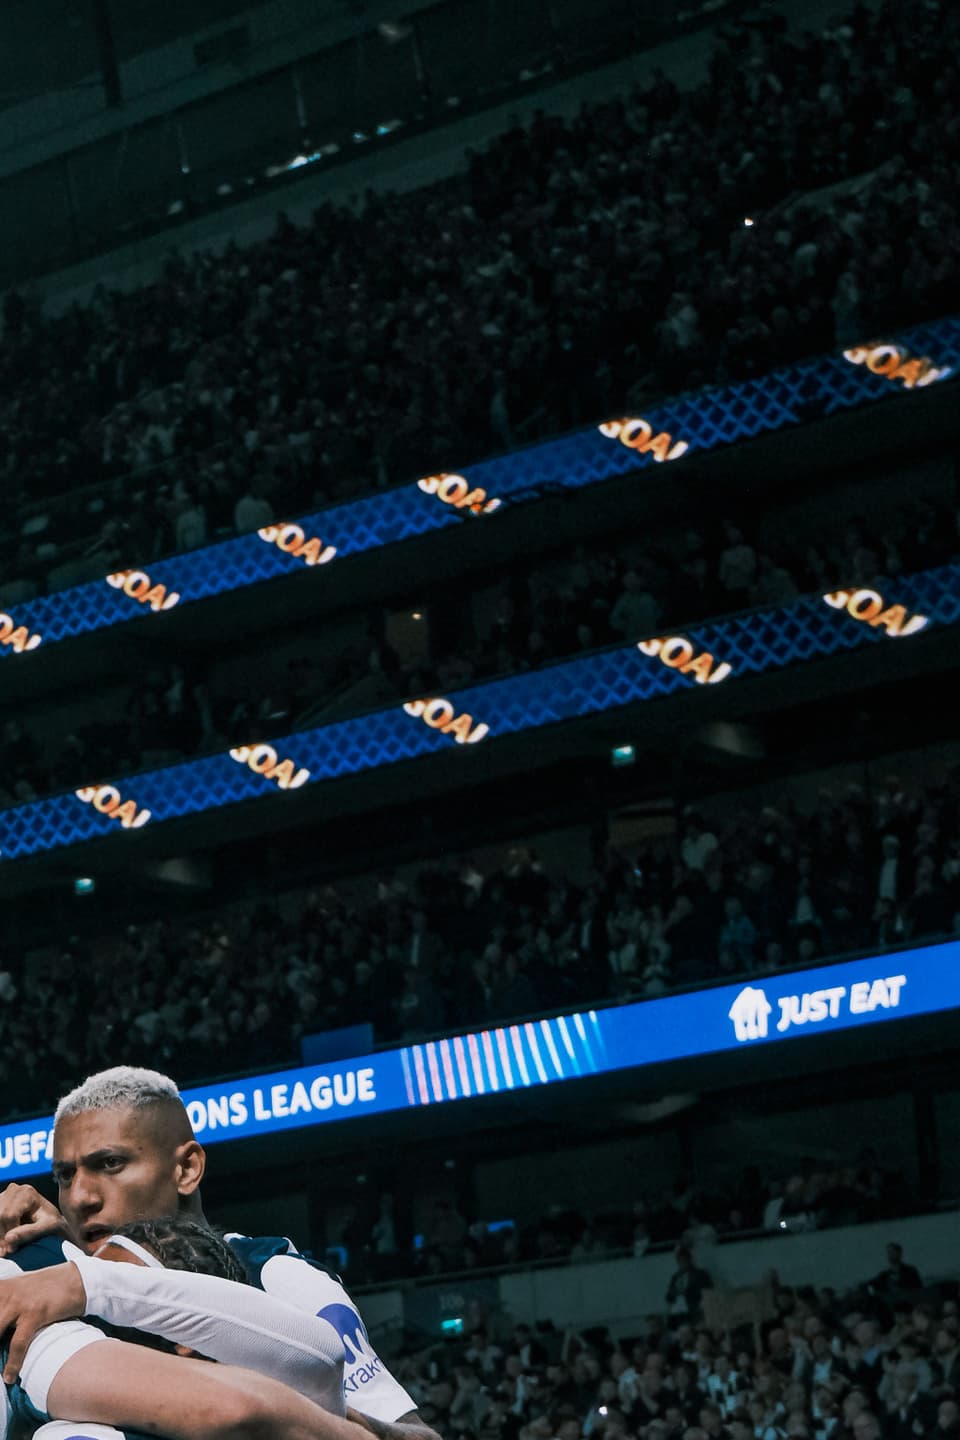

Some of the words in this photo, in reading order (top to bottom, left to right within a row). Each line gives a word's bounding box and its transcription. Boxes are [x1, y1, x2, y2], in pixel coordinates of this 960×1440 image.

[776, 986, 847, 1032] JUST
[849, 974, 908, 1014] EAT
[186, 1092, 248, 1133] ONS
[253, 1068, 377, 1121] LEAGUE
